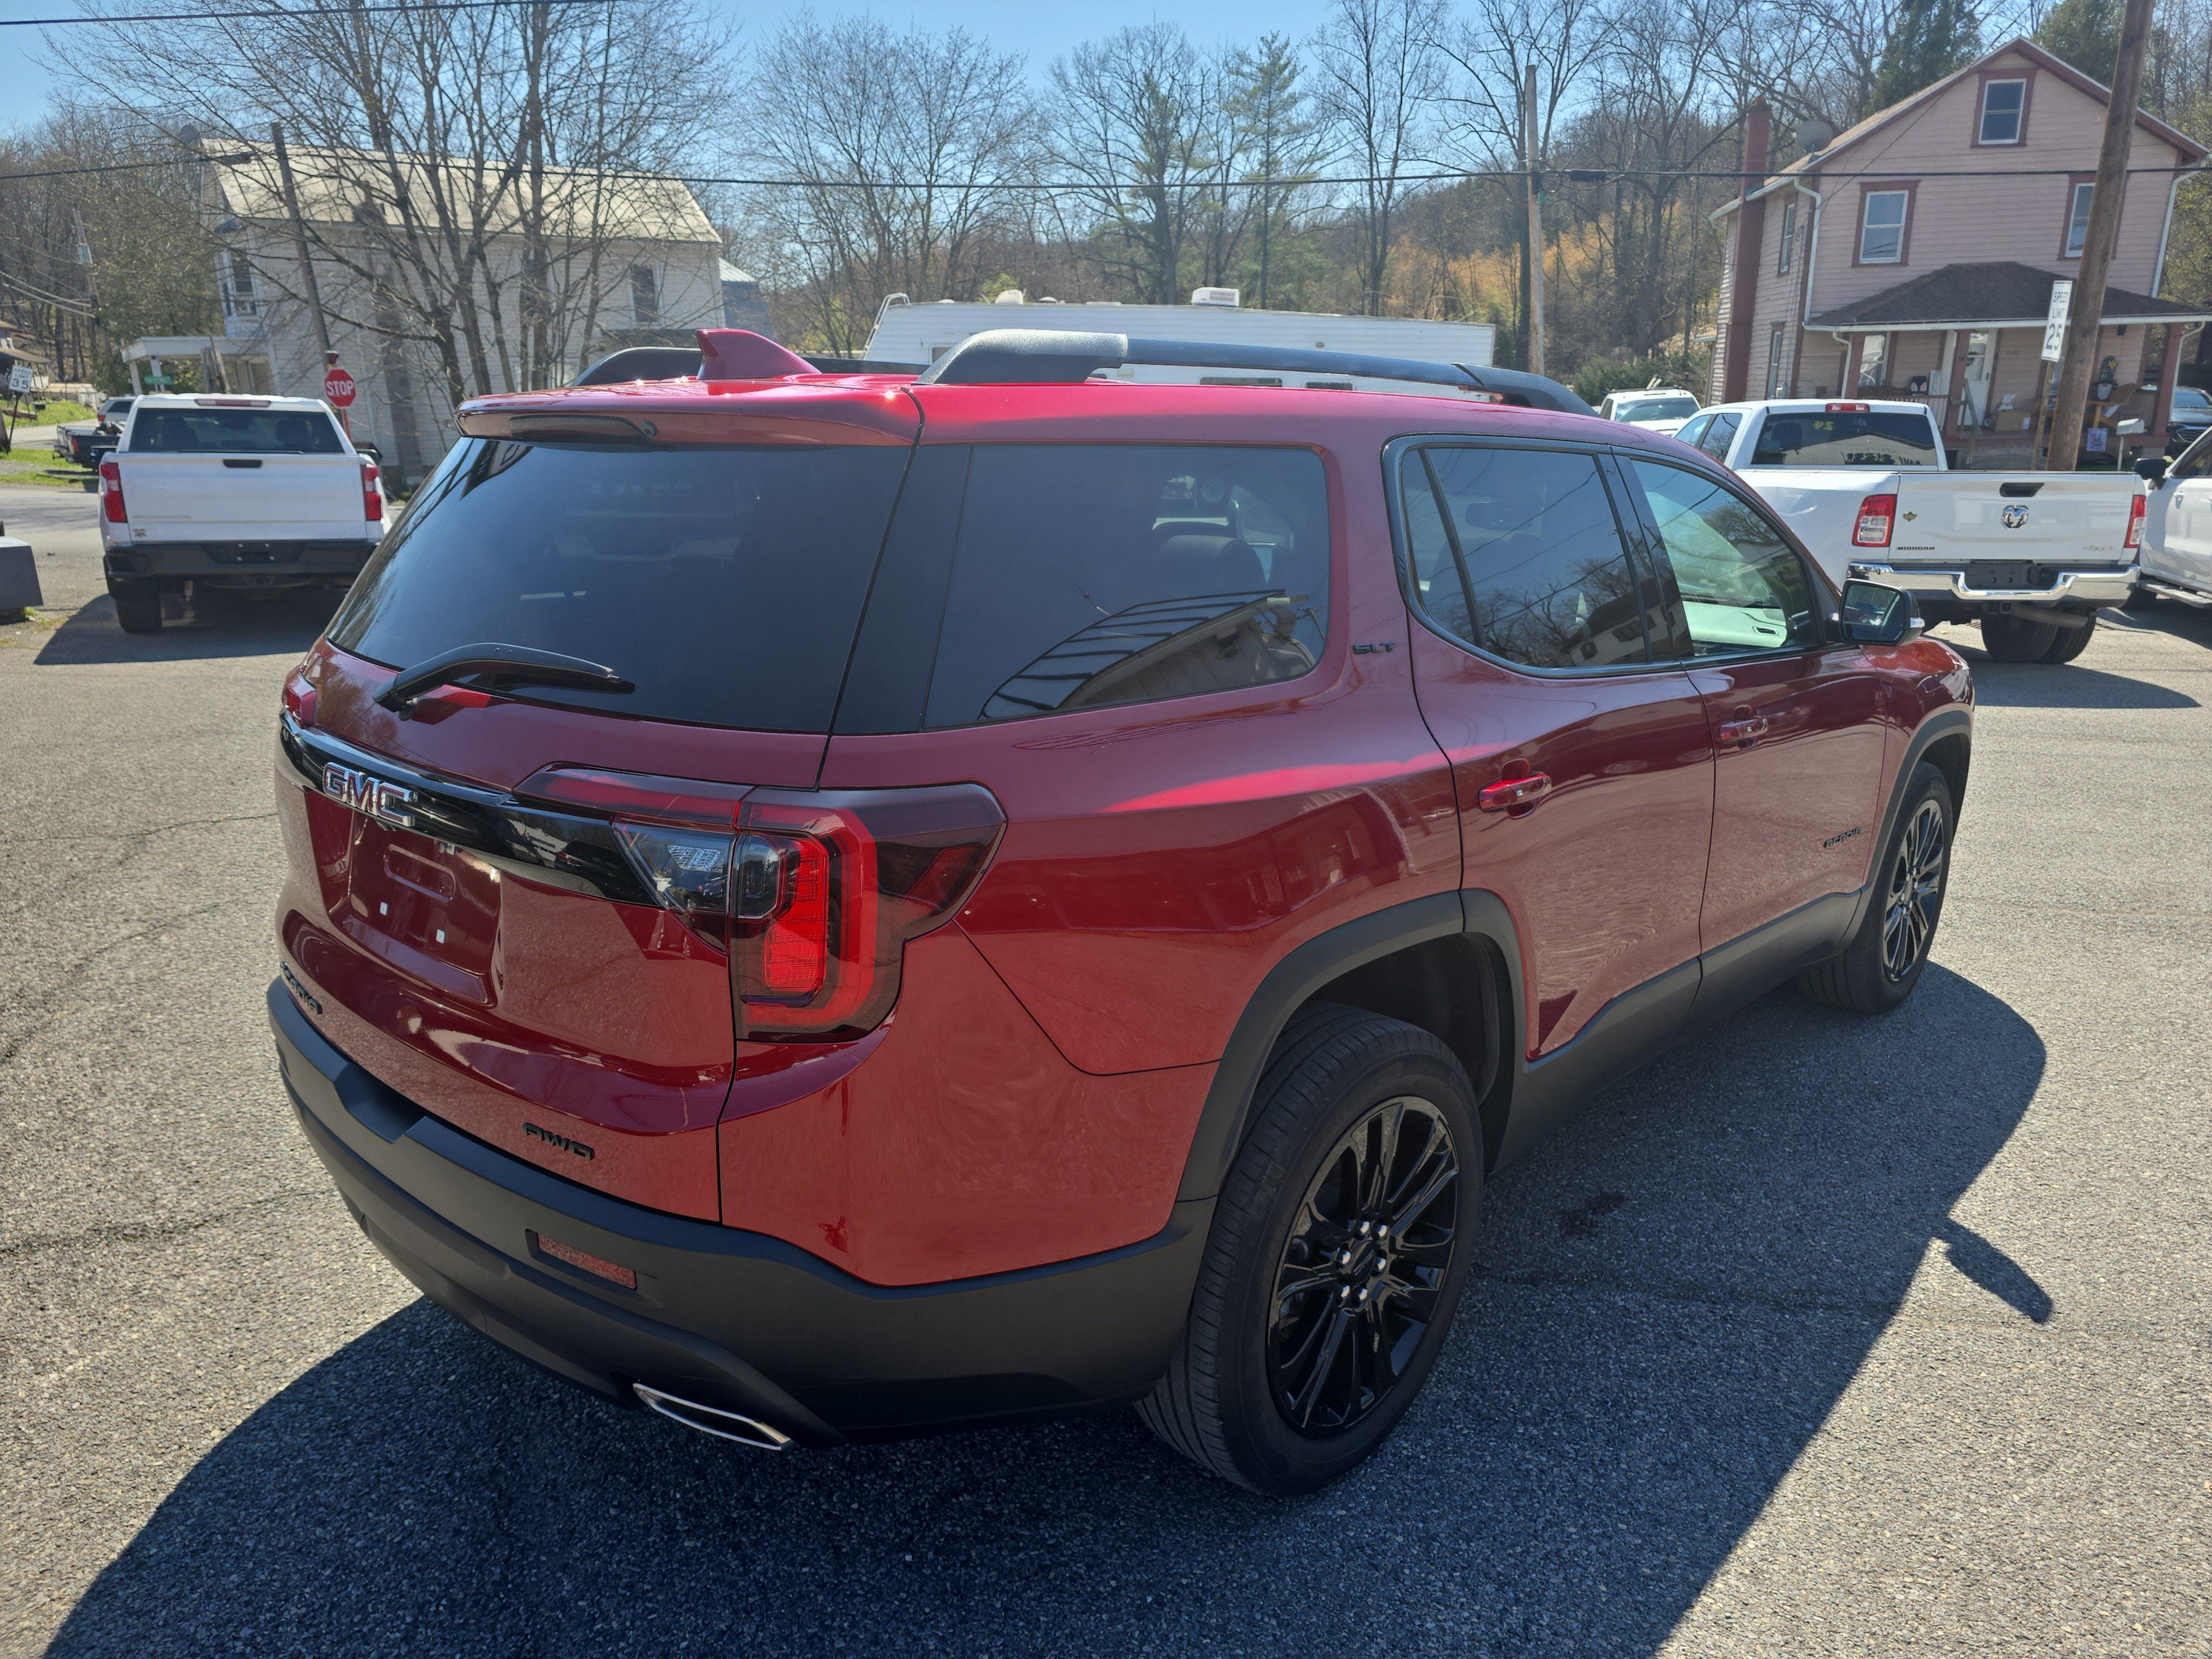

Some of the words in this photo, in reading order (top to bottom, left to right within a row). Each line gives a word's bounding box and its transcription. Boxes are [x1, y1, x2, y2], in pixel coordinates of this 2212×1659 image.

[2053, 291, 2068, 303] SPEED
[2046, 323, 2062, 351] 25
[12, 378, 29, 389] 35
[326, 380, 353, 396] STOP
[1352, 641, 1397, 654] SLT
[323, 762, 418, 827] GMC
[1823, 827, 1862, 849] ACADIA
[522, 1122, 595, 1160] AWD
